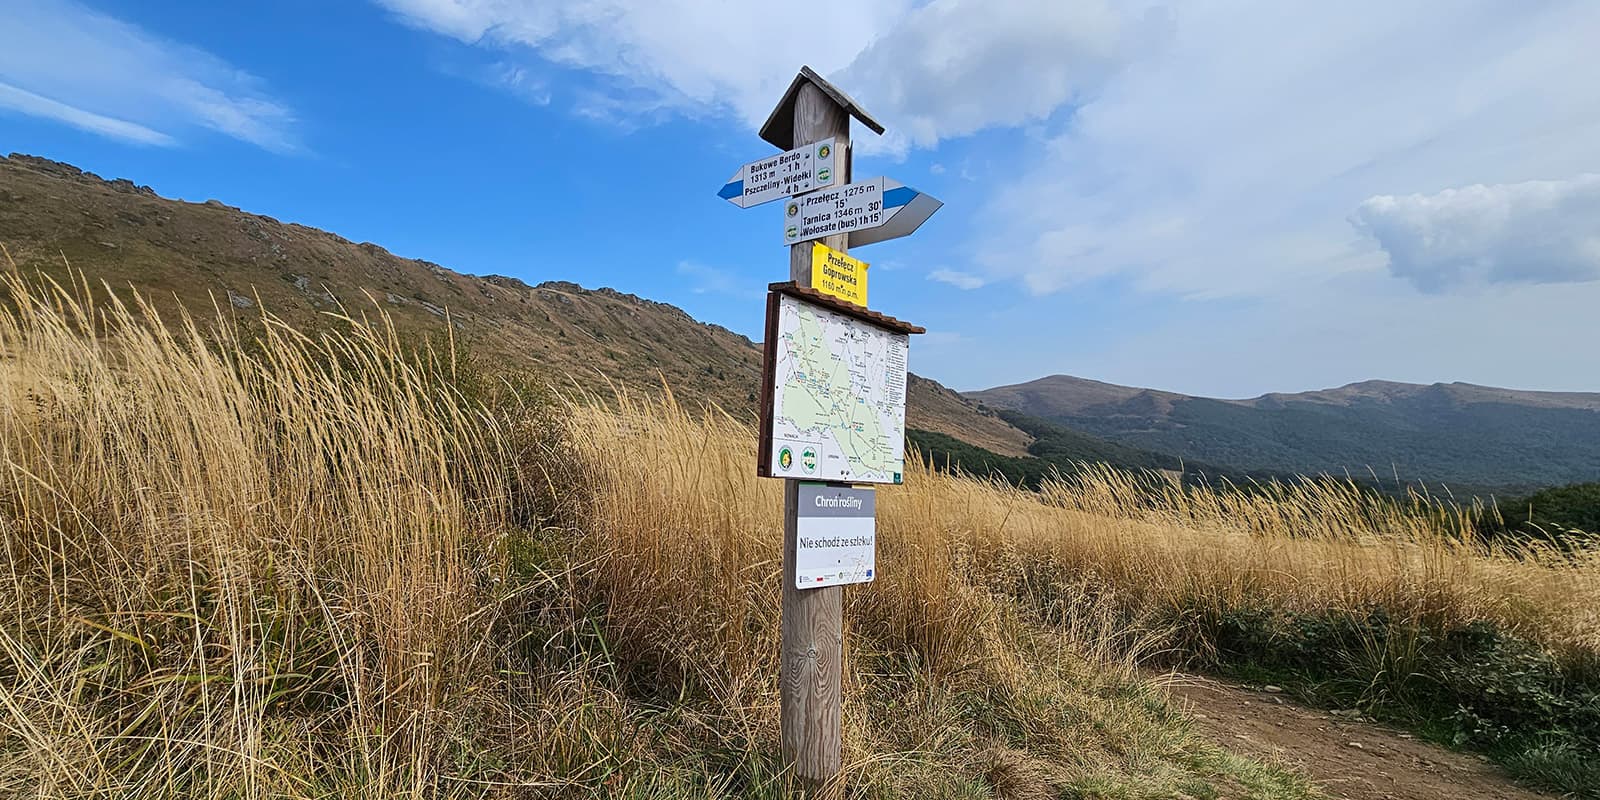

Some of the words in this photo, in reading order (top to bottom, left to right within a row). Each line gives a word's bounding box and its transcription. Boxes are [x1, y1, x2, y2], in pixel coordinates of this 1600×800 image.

[750, 159, 778, 174] Bukowe
[779, 152, 801, 165] Berdo
[744, 169, 812, 196] Pszczeliny-Widełki
[750, 172, 768, 183] 1313
[806, 192, 839, 206] Przełęcz
[844, 186, 864, 197] 1275
[866, 184, 875, 192] m
[803, 213, 831, 226] Tarnica
[834, 207, 854, 219] 1346
[802, 222, 836, 237] Wołosate
[838, 218, 857, 231] (bus)
[827, 253, 854, 272] Przełęcz
[823, 264, 857, 286] Goprowska
[815, 495, 838, 508] Chroń
[839, 496, 863, 510] rośliny
[799, 537, 814, 549] Nie
[814, 536, 840, 549] schodź
[841, 538, 849, 547] ze
[849, 536, 873, 547] szlaku!
